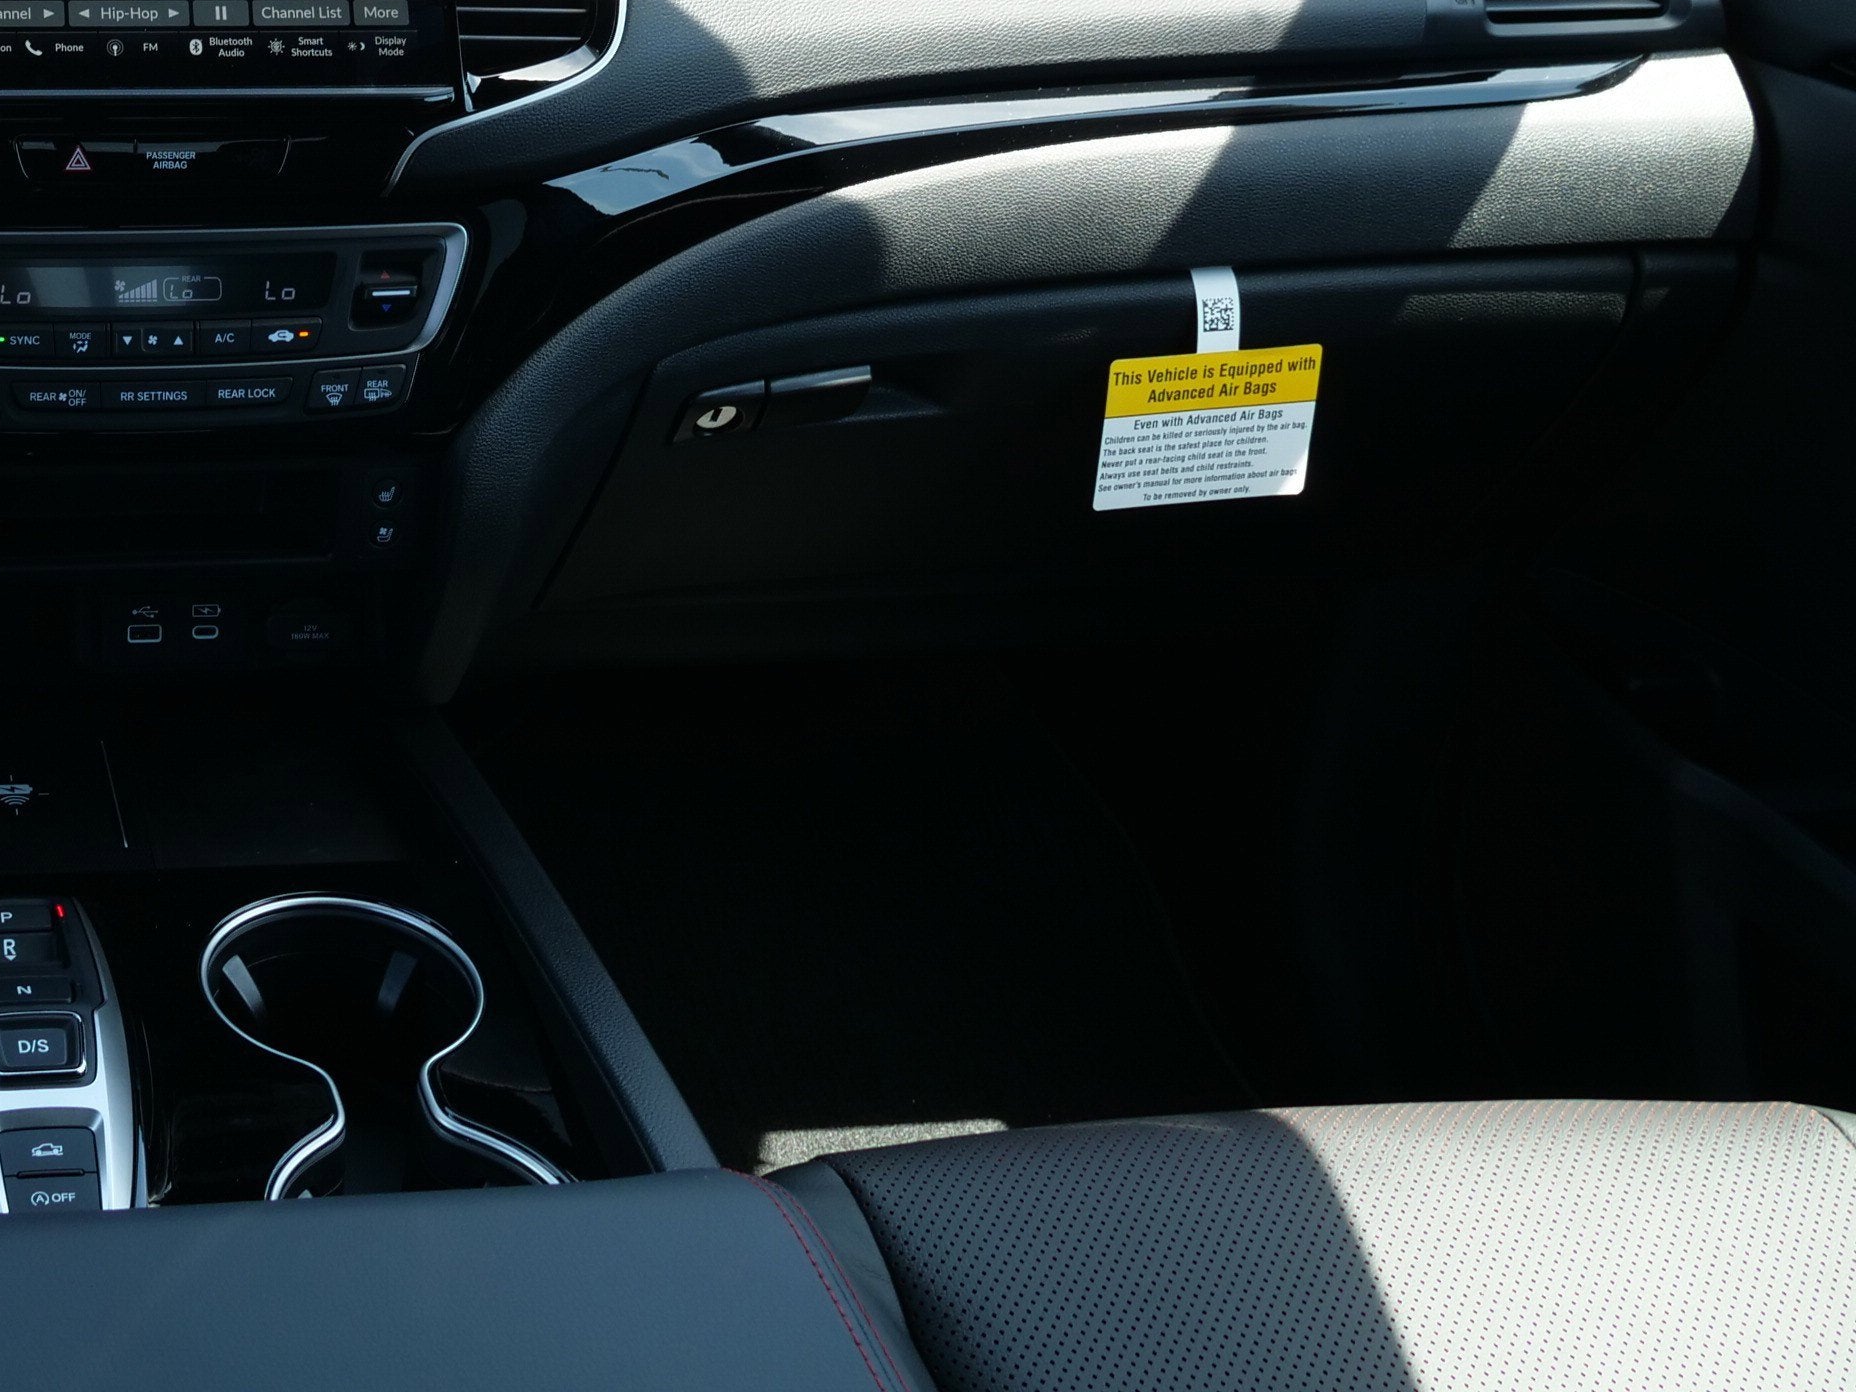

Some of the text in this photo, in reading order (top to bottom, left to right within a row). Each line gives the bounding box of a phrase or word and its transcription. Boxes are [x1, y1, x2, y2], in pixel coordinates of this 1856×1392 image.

[100, 7, 159, 23] Hip-Hop
[261, 6, 343, 19] Channel List
[364, 6, 399, 19] More
[209, 36, 253, 47] Bluetooth
[298, 36, 324, 46] Smart
[375, 36, 407, 48] Display
[55, 42, 84, 53] Phone
[143, 43, 159, 52] FM
[218, 48, 245, 57] Audio
[291, 47, 333, 57] Shortcuts
[379, 47, 405, 57] Mode
[146, 151, 196, 160] PASSENGER
[153, 160, 188, 170] AIRBAG
[0, 284, 31, 305] Lo
[265, 280, 296, 301] Lo
[10, 335, 40, 346] SYNC
[69, 332, 92, 340] MODE
[215, 333, 235, 343] A/C
[1113, 356, 1316, 386] This Vehicle is Equipped with
[321, 383, 349, 393] FRONT
[367, 379, 389, 388] REAR
[30, 392, 56, 402] REAR
[68, 389, 87, 398] ON/
[120, 391, 188, 402] RR SETTINGS
[218, 388, 276, 399] REAR LOCK
[1147, 381, 1277, 403] Advanced Air Bags
[68, 397, 87, 407] OFF
[1133, 409, 1284, 430] Even with Advanced Air Bags
[1104, 435, 1135, 445] Children
[1136, 434, 1150, 442] can
[1151, 433, 1161, 441] be
[1162, 430, 1184, 439] killed
[1194, 427, 1227, 437] seriously
[1229, 425, 1255, 435] injured
[1256, 423, 1265, 432] by
[1266, 423, 1279, 431] the
[1291, 420, 1308, 430] bag.
[1143, 485, 1251, 501] To be removed by owner only.
[0, 912, 13, 923] P
[3, 938, 16, 955] R
[16, 985, 32, 995] N
[17, 1039, 49, 1053] D/S
[51, 1192, 76, 1203] OFF
